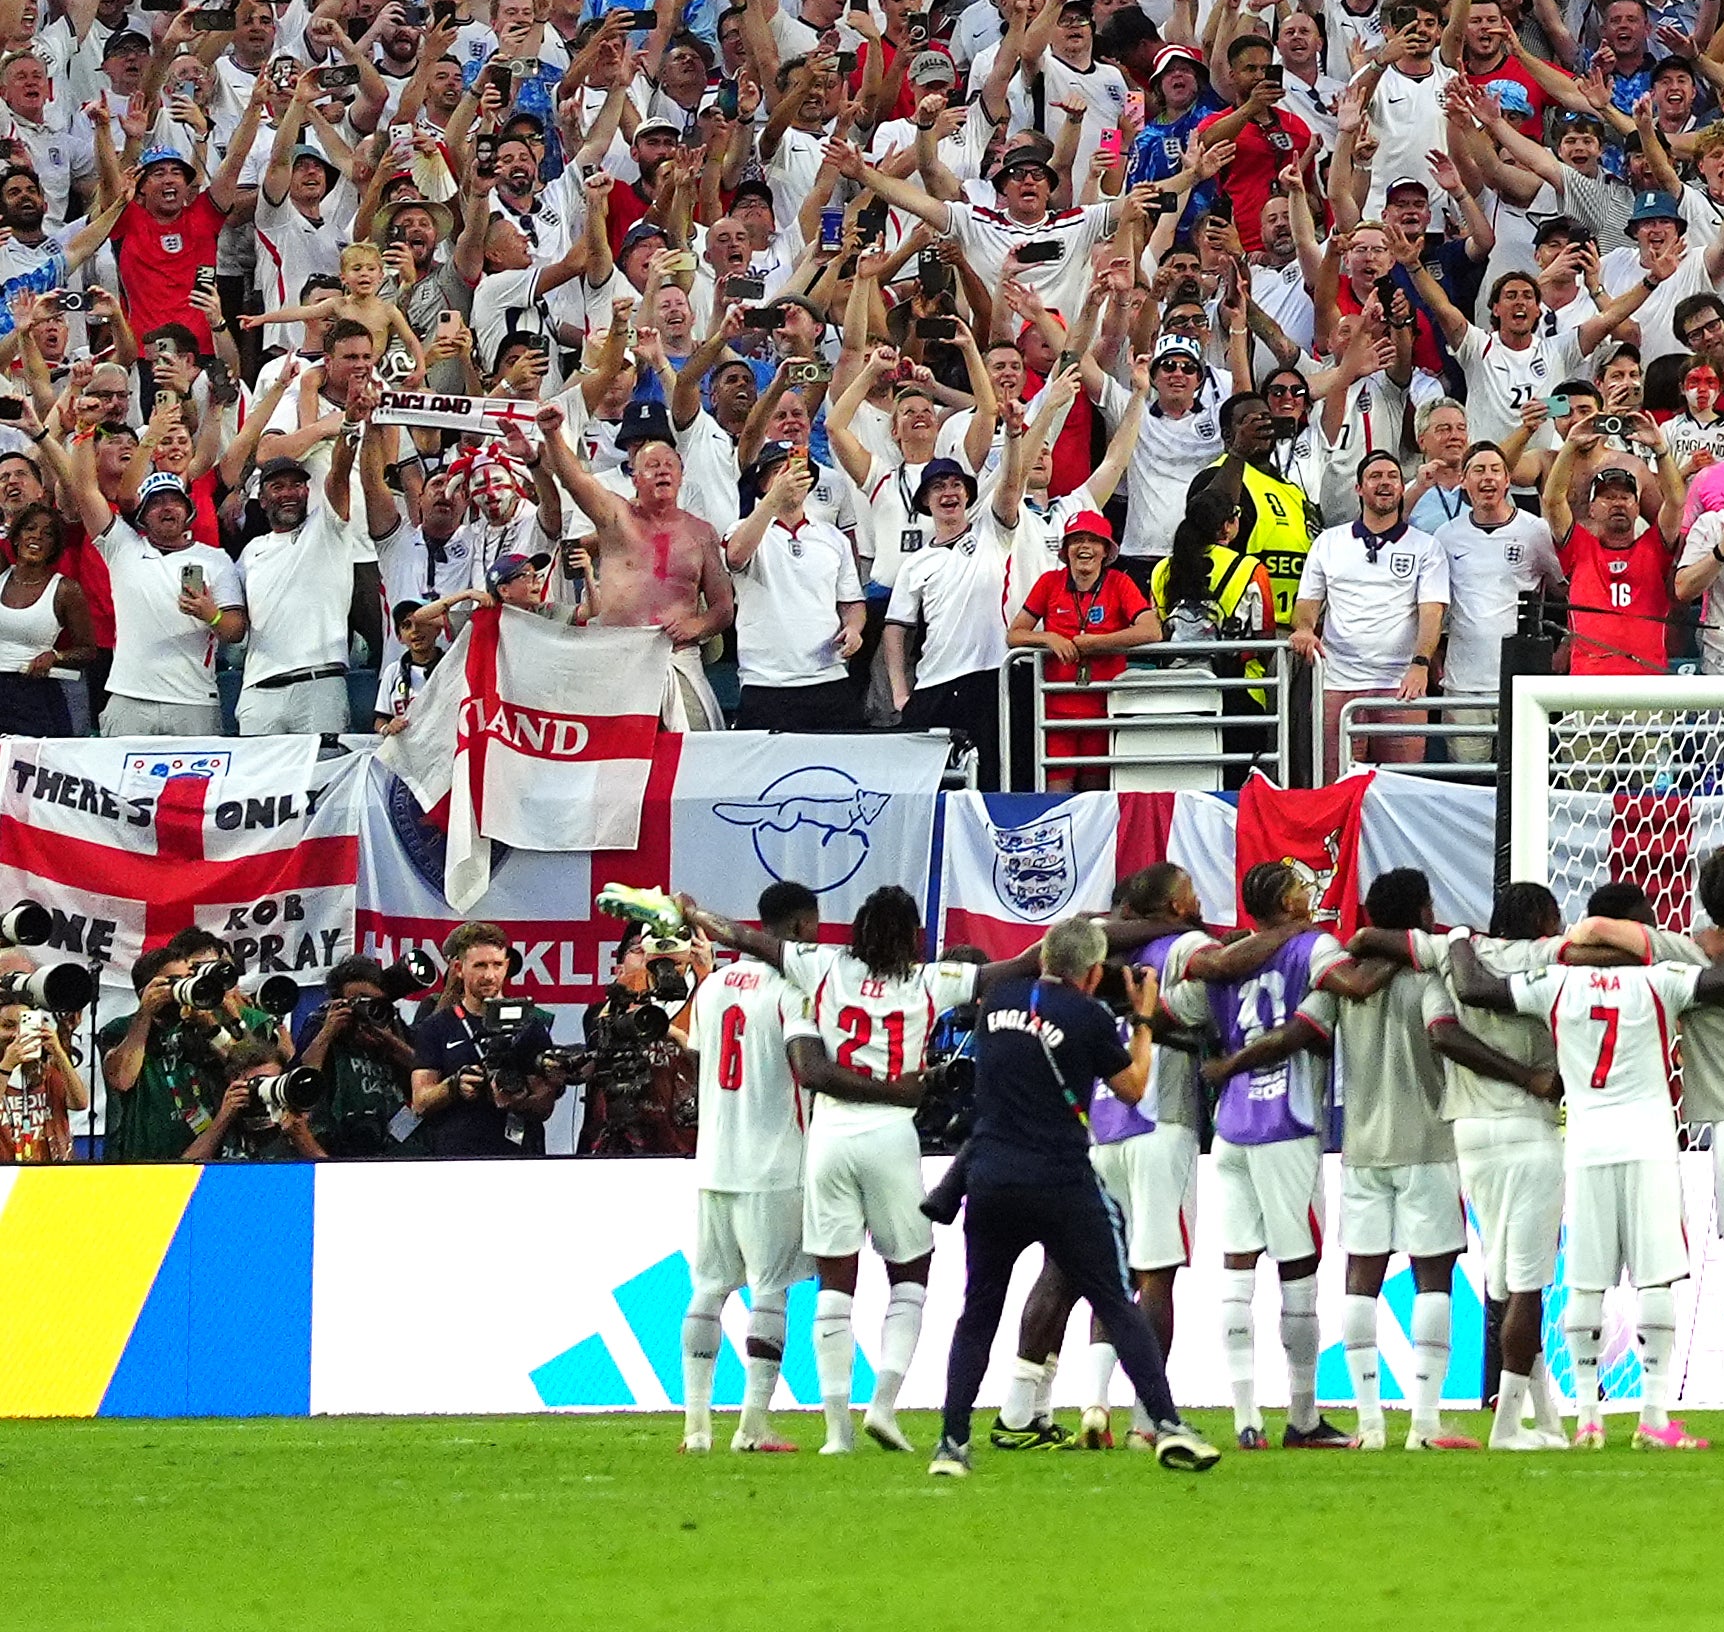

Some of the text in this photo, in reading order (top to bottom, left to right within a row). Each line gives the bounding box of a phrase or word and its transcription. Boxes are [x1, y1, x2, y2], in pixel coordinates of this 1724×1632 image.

[379, 393, 471, 416] ENGLAND
[1509, 386, 1533, 409] 21
[1610, 582, 1632, 608] 16
[215, 782, 331, 831] ONLY
[223, 894, 306, 931] ROB
[861, 979, 888, 998] EZE
[837, 1005, 905, 1084] 21
[984, 1009, 1063, 1047] ENGLAND
[719, 1005, 746, 1090] 6
[1590, 1006, 1619, 1088] 7
